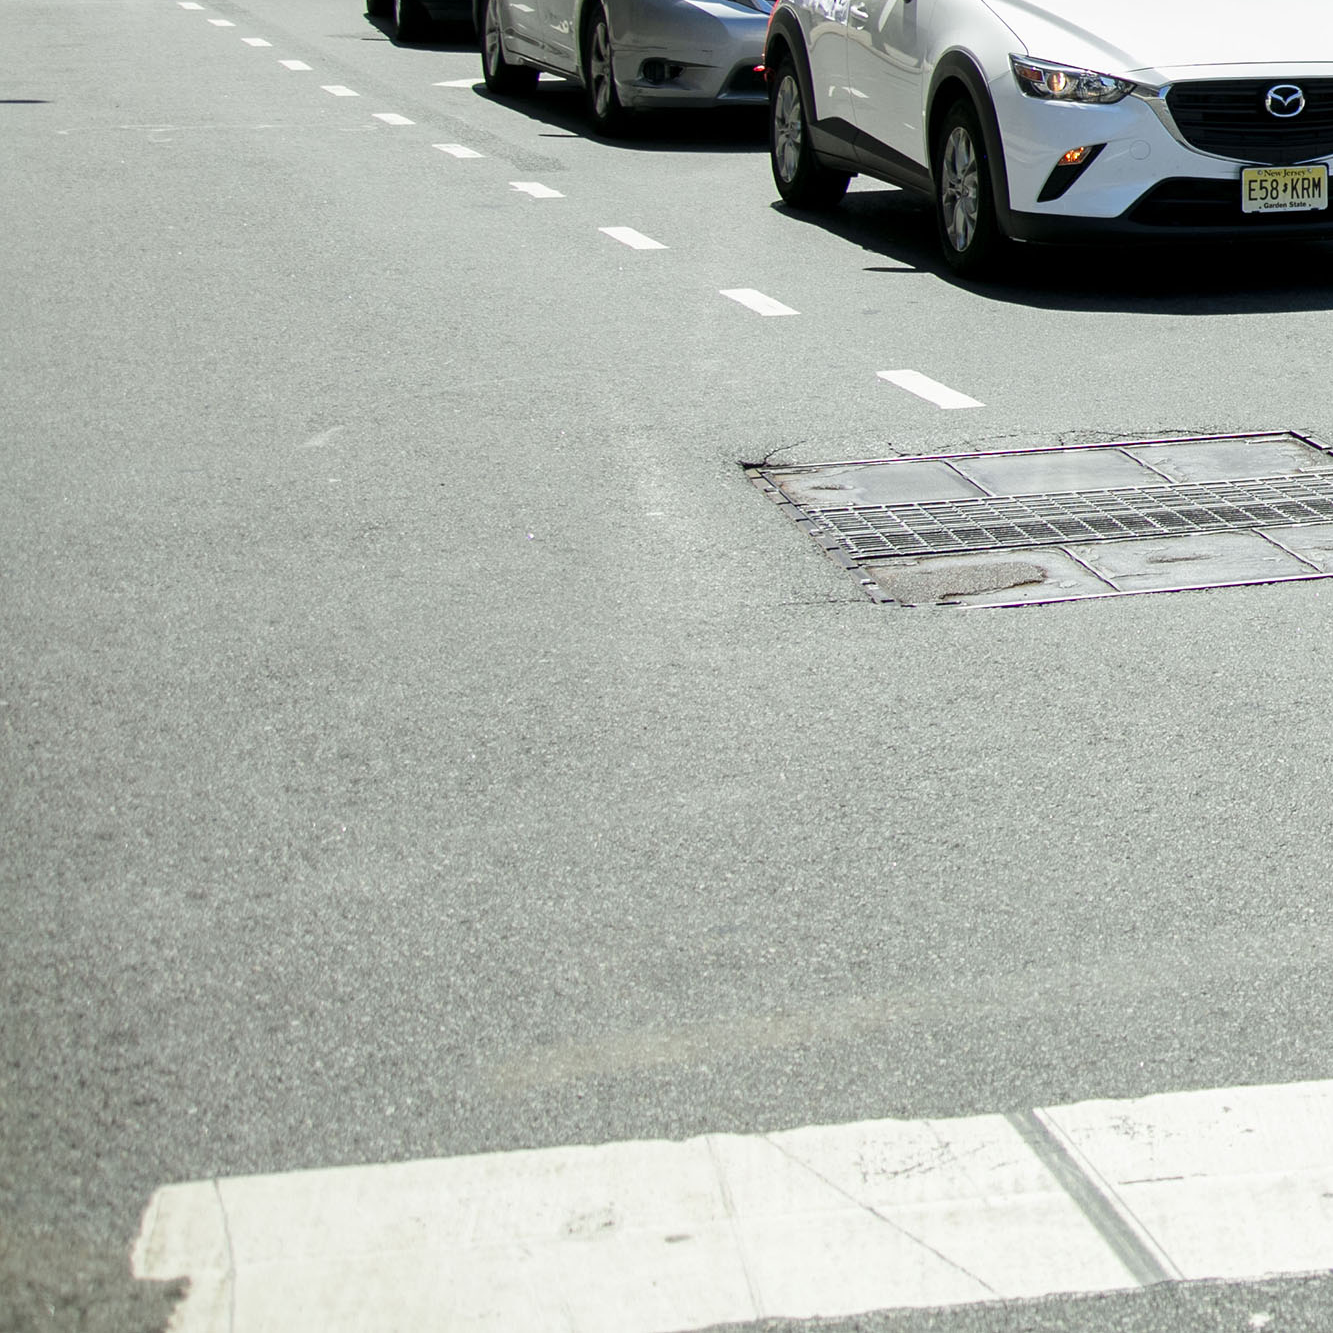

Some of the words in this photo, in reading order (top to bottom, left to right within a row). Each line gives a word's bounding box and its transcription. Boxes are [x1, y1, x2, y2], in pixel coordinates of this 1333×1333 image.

[1282, 169, 1306, 178] Jersey
[1248, 179, 1279, 201] E58
[1290, 177, 1321, 199] KRM
